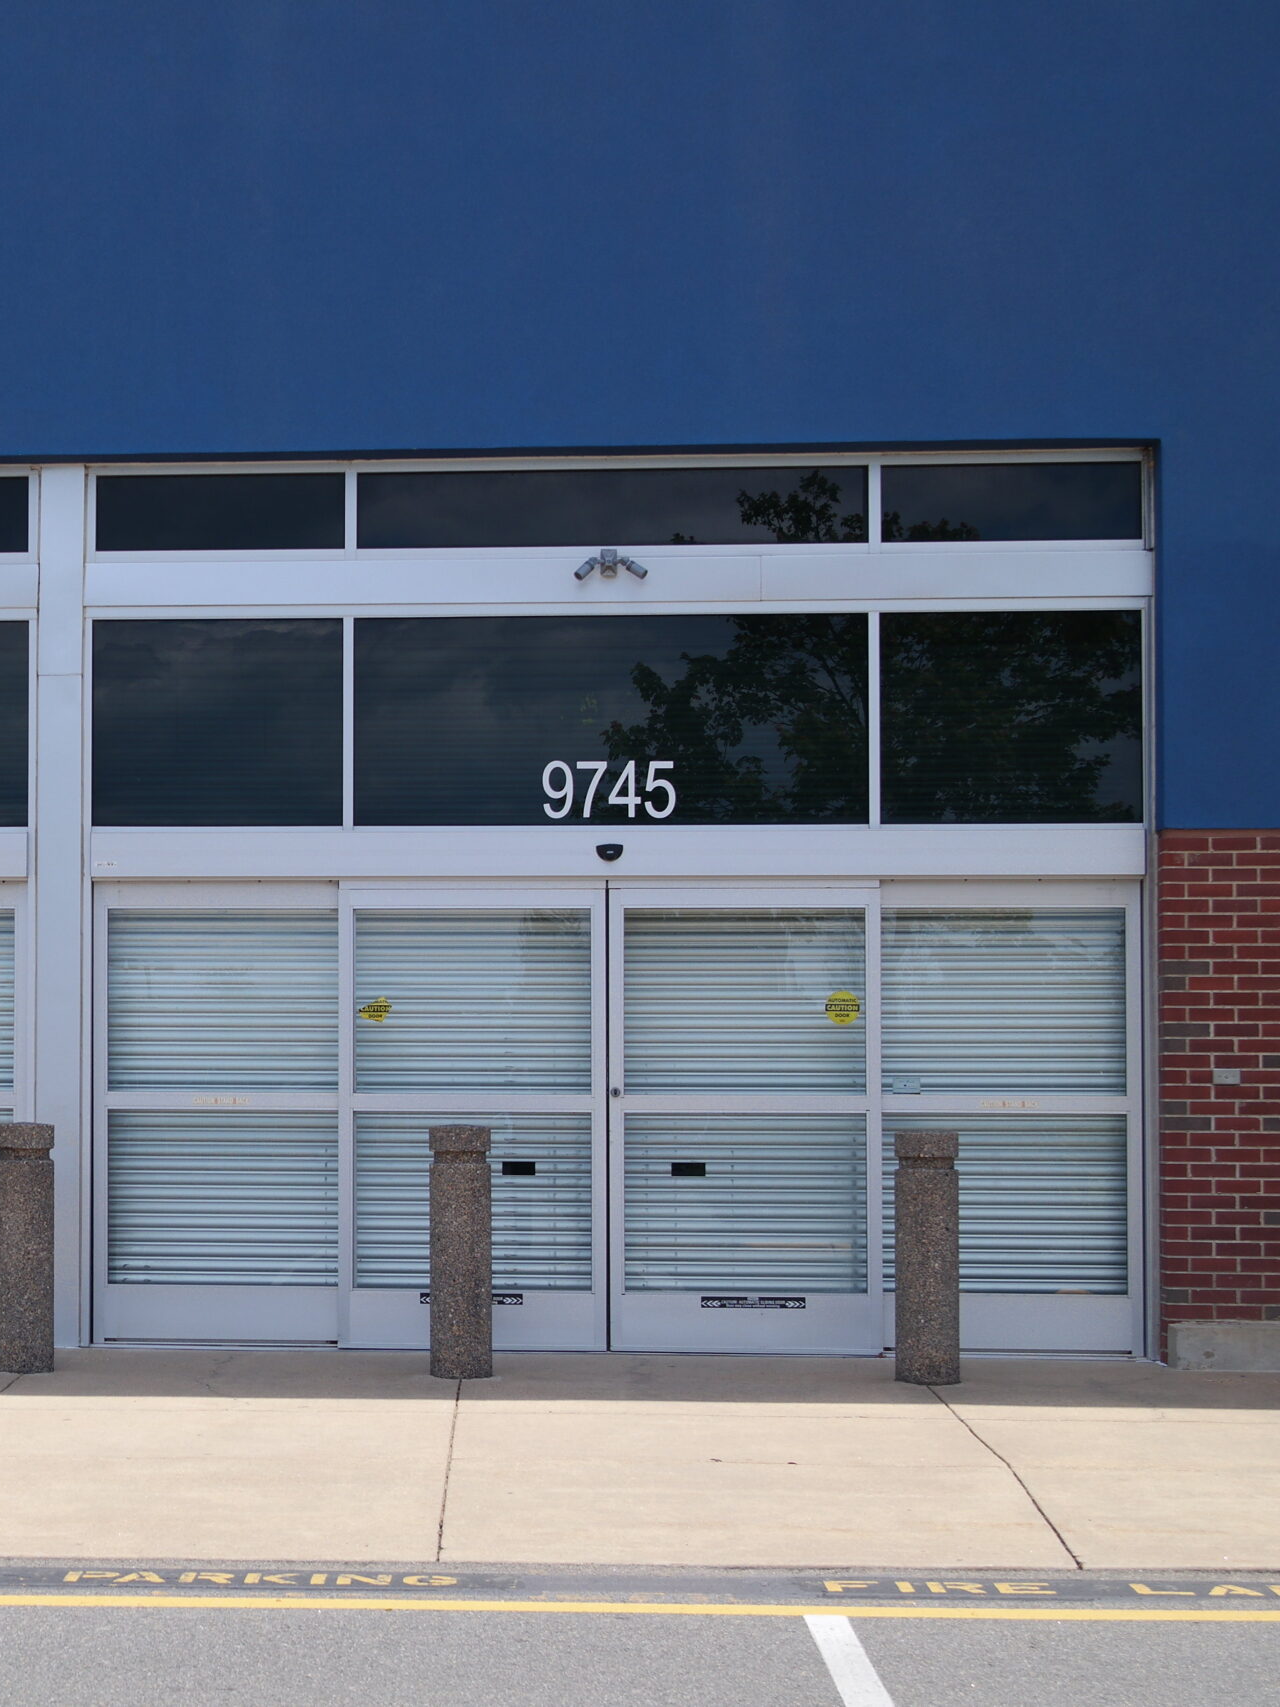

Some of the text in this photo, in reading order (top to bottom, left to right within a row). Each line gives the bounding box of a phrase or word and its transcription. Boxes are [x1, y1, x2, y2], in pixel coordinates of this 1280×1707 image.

[542, 760, 677, 819] 9745
[63, 1571, 458, 1586] PARKING
[823, 1580, 1057, 1595] FIRE
[1128, 1583, 1280, 1597] LA
